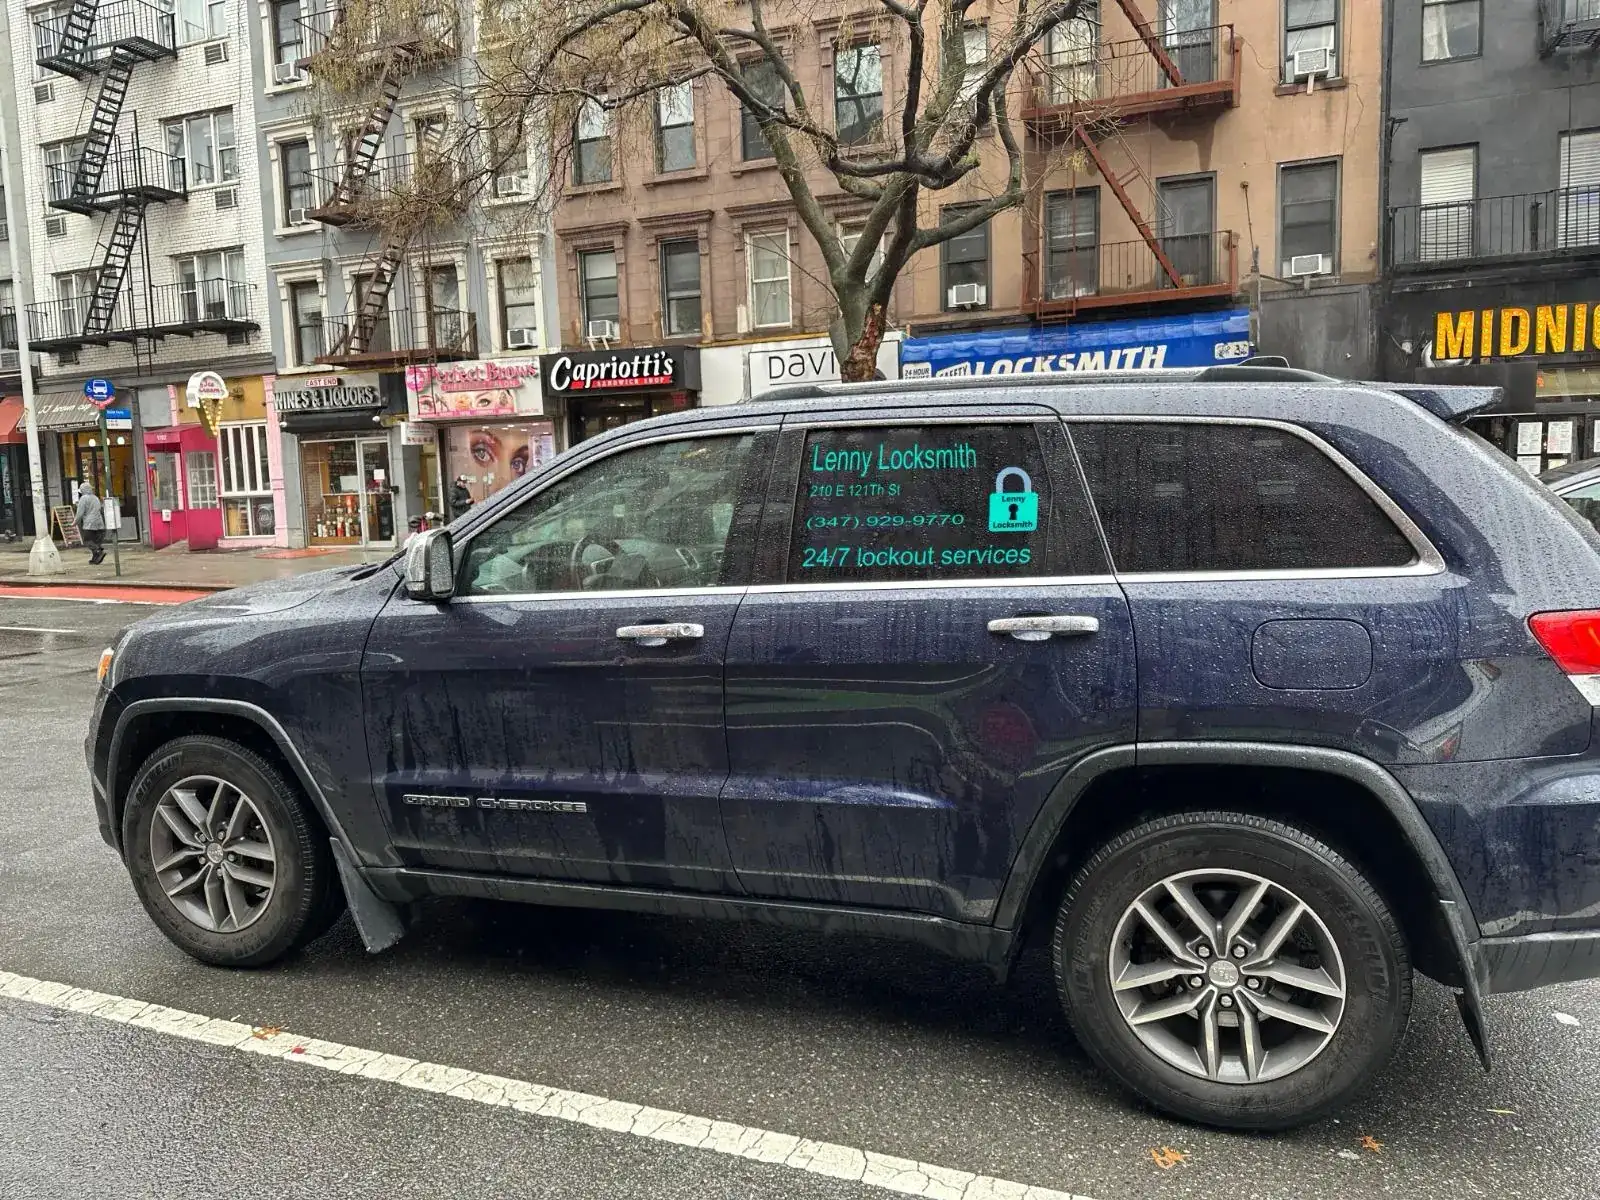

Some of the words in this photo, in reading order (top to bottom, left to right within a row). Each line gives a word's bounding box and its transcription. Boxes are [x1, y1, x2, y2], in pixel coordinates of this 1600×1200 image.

[426, 364, 482, 383] Perfect
[550, 350, 674, 391] Capriotti's
[904, 369, 914, 377] 24
[912, 367, 930, 376] HOUR
[938, 364, 968, 377] FETY
[597, 378, 640, 387] SANDWICH
[643, 376, 665, 384] SHOP
[275, 390, 310, 410] WINES
[311, 389, 322, 408] &
[323, 386, 374, 407] LIQUORS
[813, 445, 872, 477] Lenny
[878, 442, 977, 470] Locksmith
[810, 485, 833, 497] 210
[835, 485, 845, 496] E
[849, 483, 885, 496] 121Th
[992, 521, 1033, 529] Locksmith
[802, 547, 850, 567] 24/7
[857, 547, 934, 566] lockout
[941, 545, 1031, 565] services
[403, 794, 470, 807] GRAND
[476, 797, 588, 813] CHEROKEE
